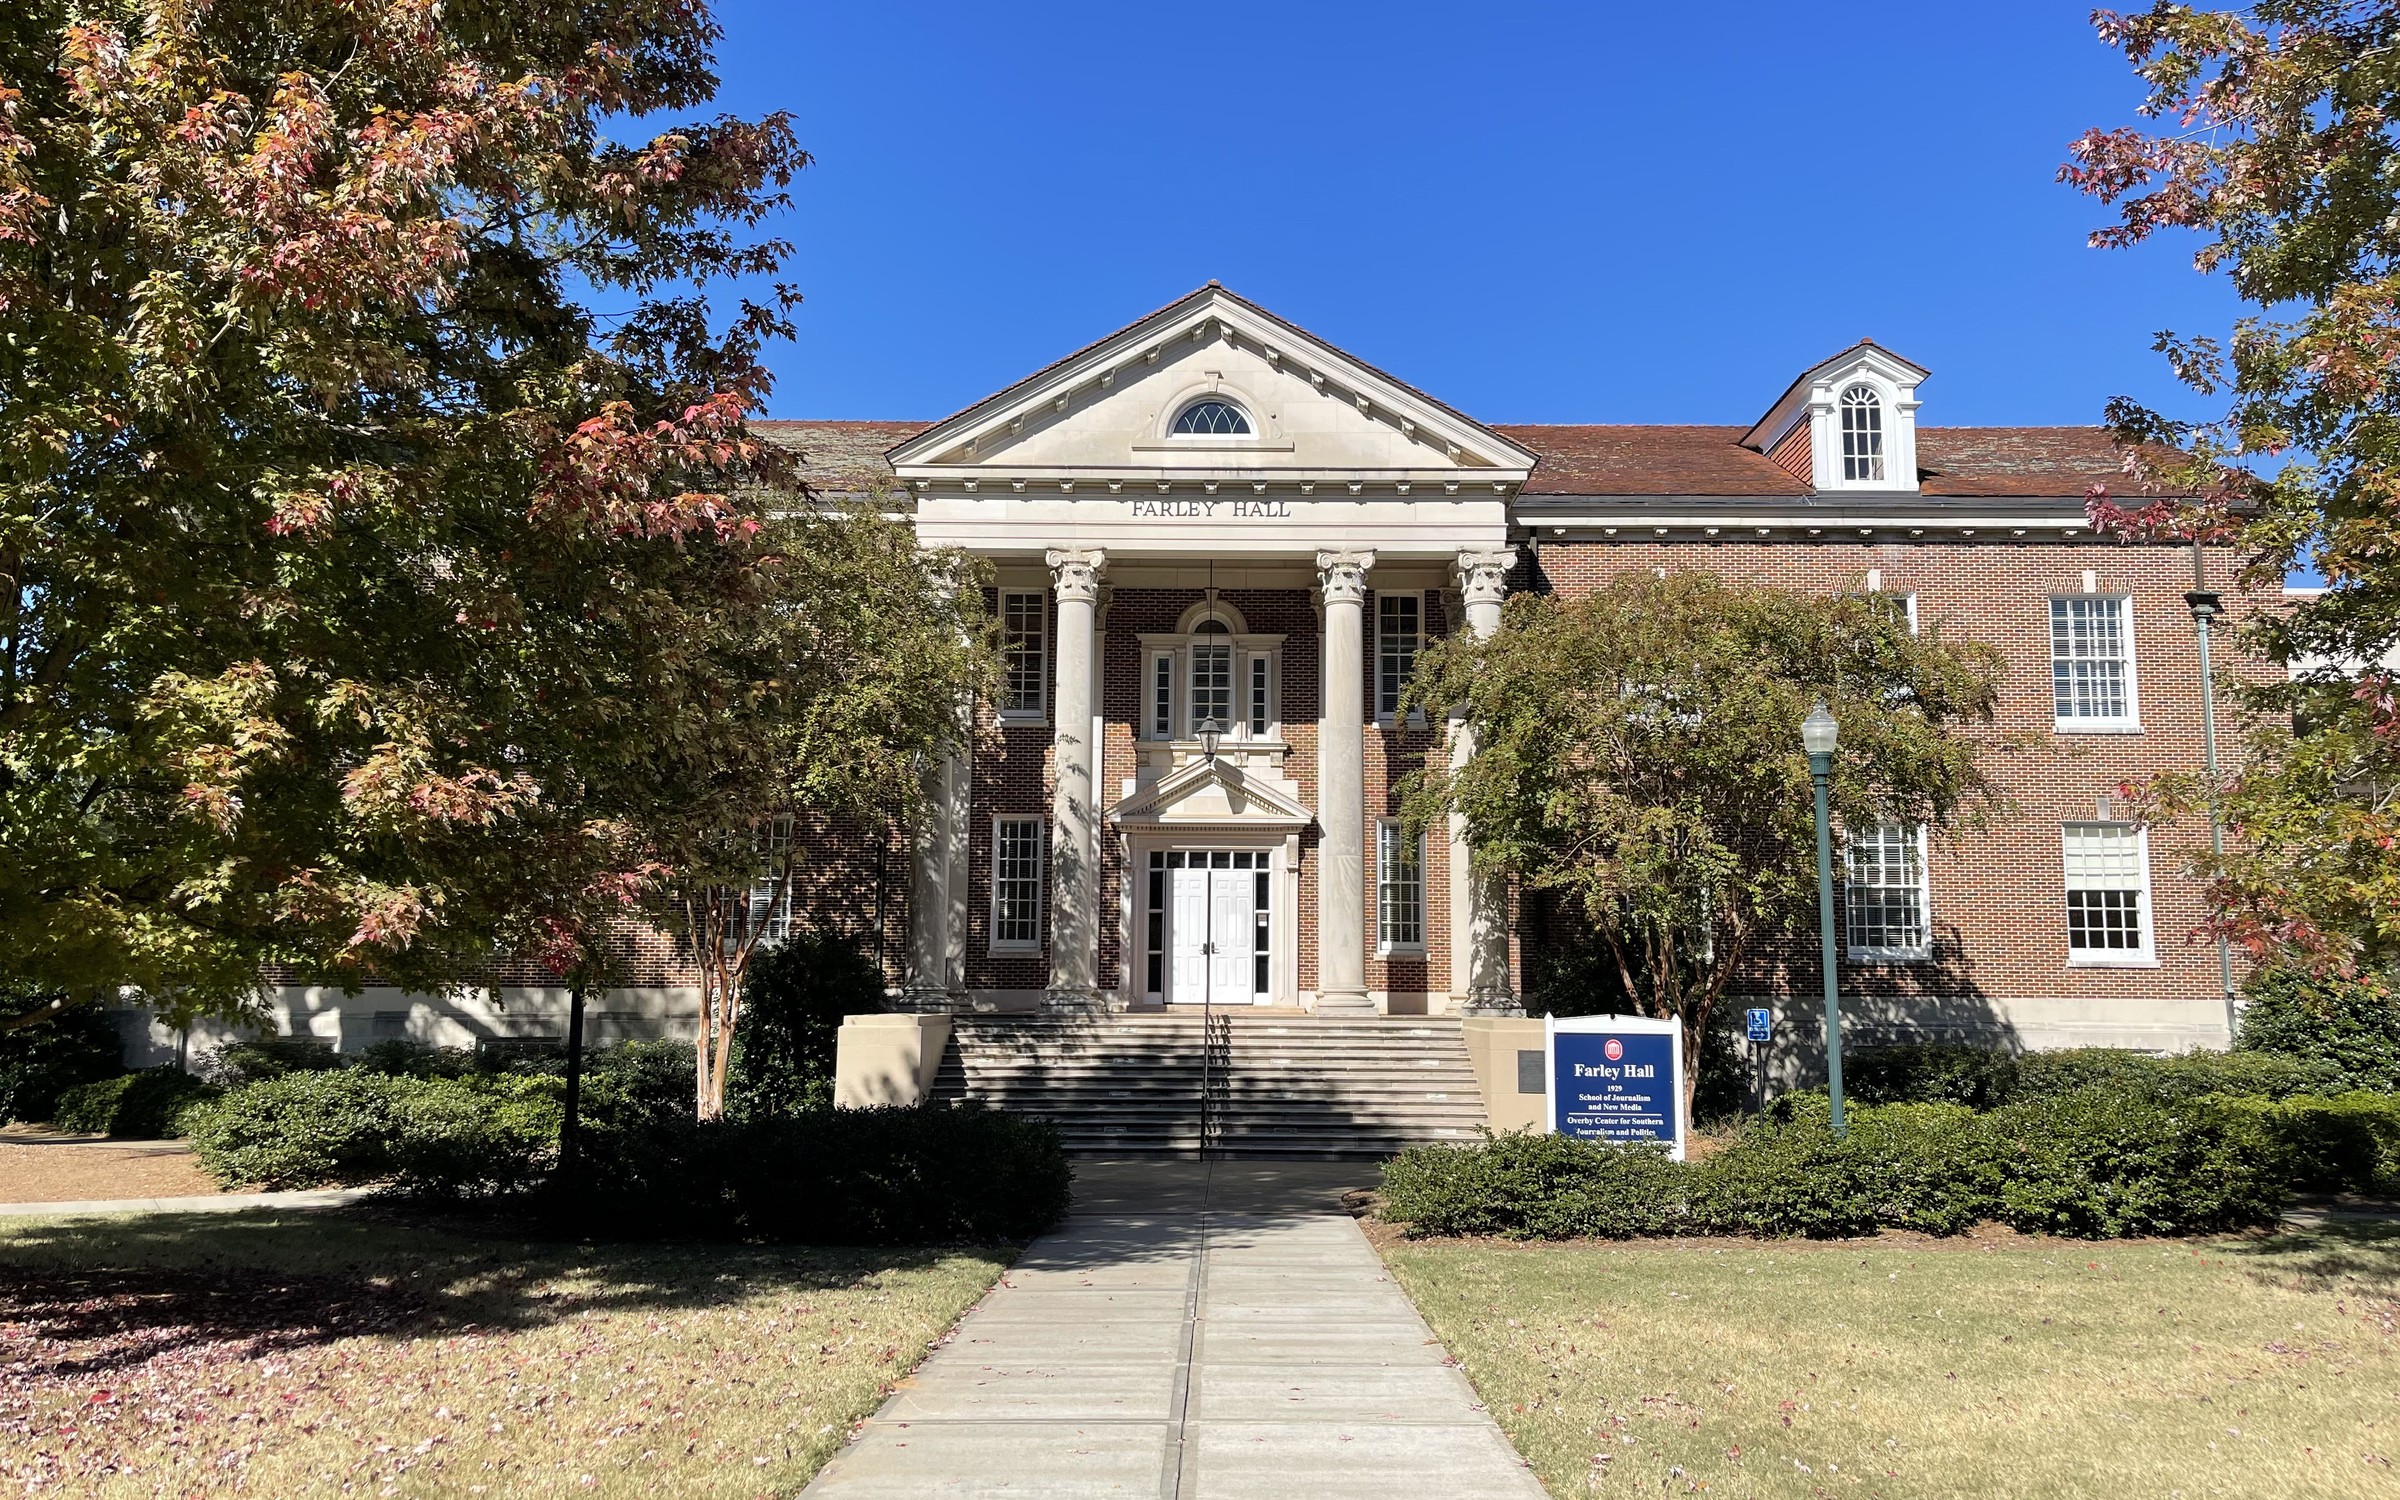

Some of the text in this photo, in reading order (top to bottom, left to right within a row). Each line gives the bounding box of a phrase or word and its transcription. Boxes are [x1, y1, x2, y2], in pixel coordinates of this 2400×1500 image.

[1132, 501, 1291, 517] FARLEY HALL
[1574, 1063, 1654, 1080] Farley Hall
[1612, 1094, 1651, 1102] Journalism
[1567, 1117, 1664, 1125] Overby Center for Southern
[1616, 1128, 1629, 1136] and
[1631, 1128, 1656, 1136] Politics
